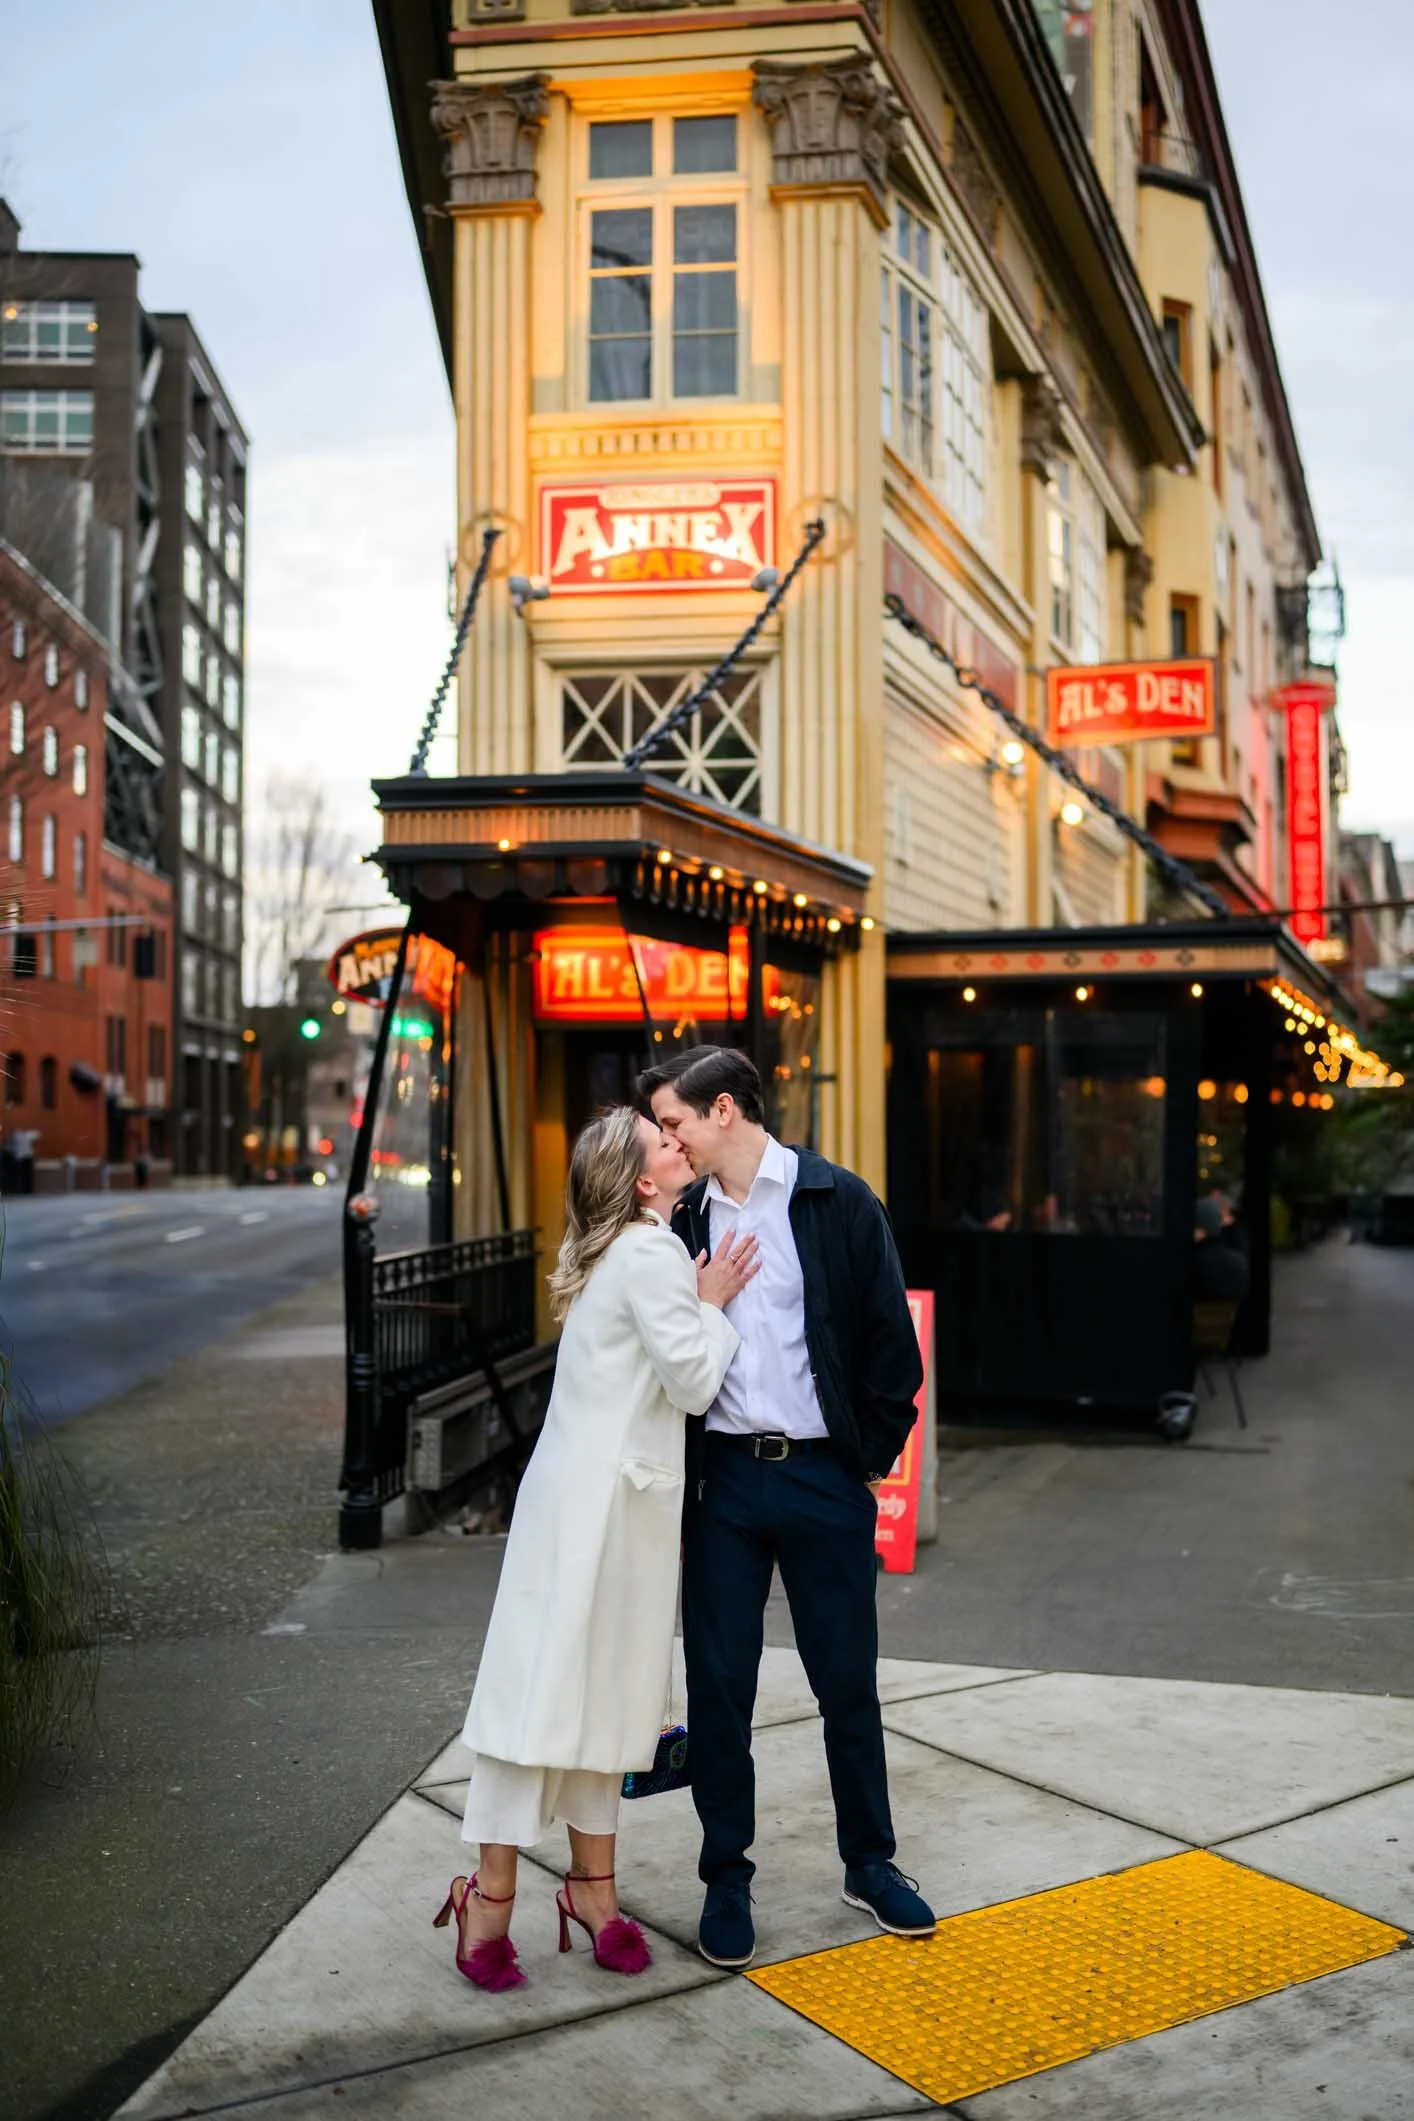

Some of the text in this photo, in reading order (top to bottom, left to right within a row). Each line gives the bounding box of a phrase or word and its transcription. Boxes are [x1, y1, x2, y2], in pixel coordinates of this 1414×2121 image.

[552, 501, 765, 577] ANNEX
[608, 550, 705, 580] BAR
[1136, 672, 1205, 719] DEN
[877, 1493, 907, 1520] edy
